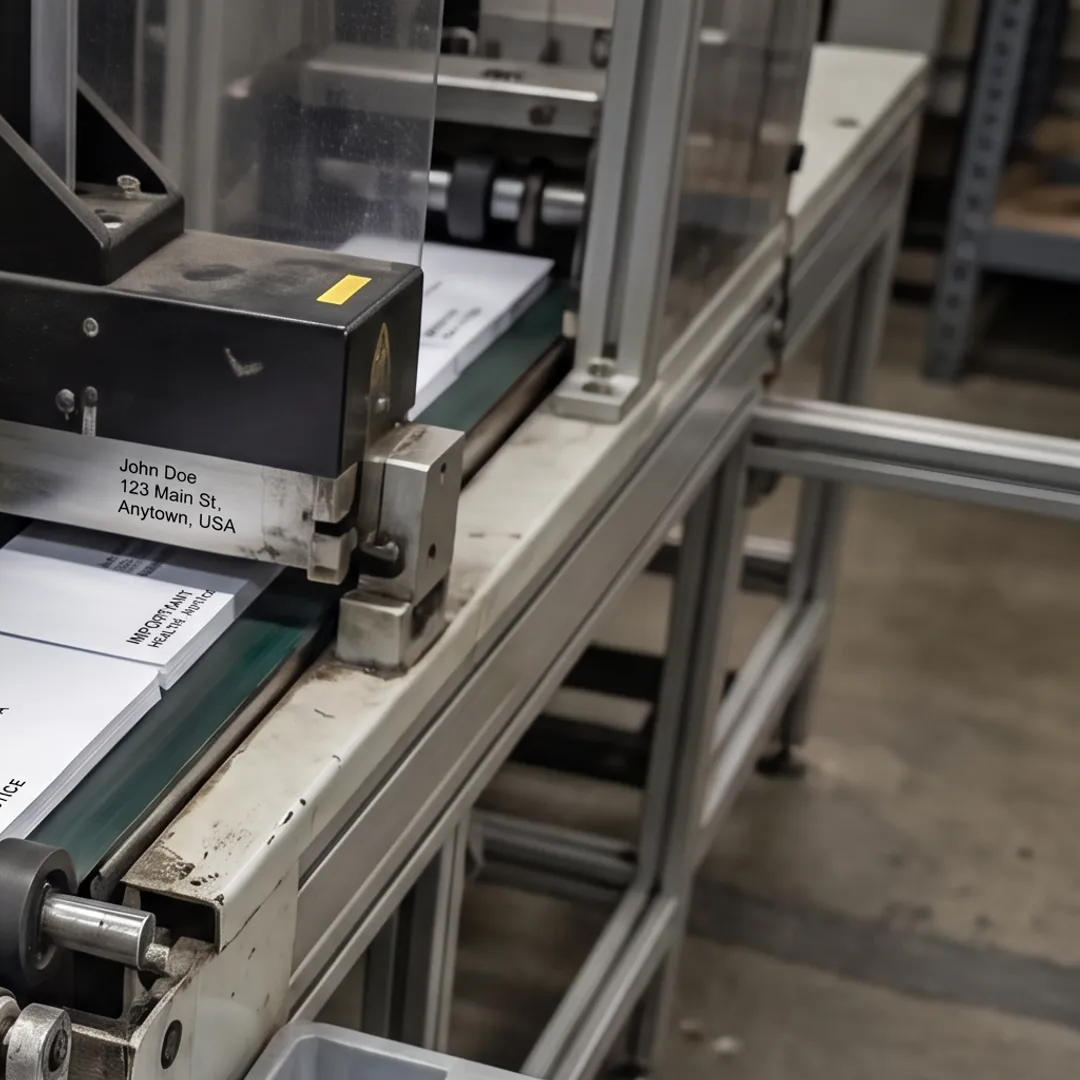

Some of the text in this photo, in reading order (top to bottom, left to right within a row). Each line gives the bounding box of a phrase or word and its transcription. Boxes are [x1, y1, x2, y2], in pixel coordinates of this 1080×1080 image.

[120, 458, 197, 485] John Doe
[120, 479, 221, 511] 123 Main St,
[118, 500, 236, 533] Anytown, USA
